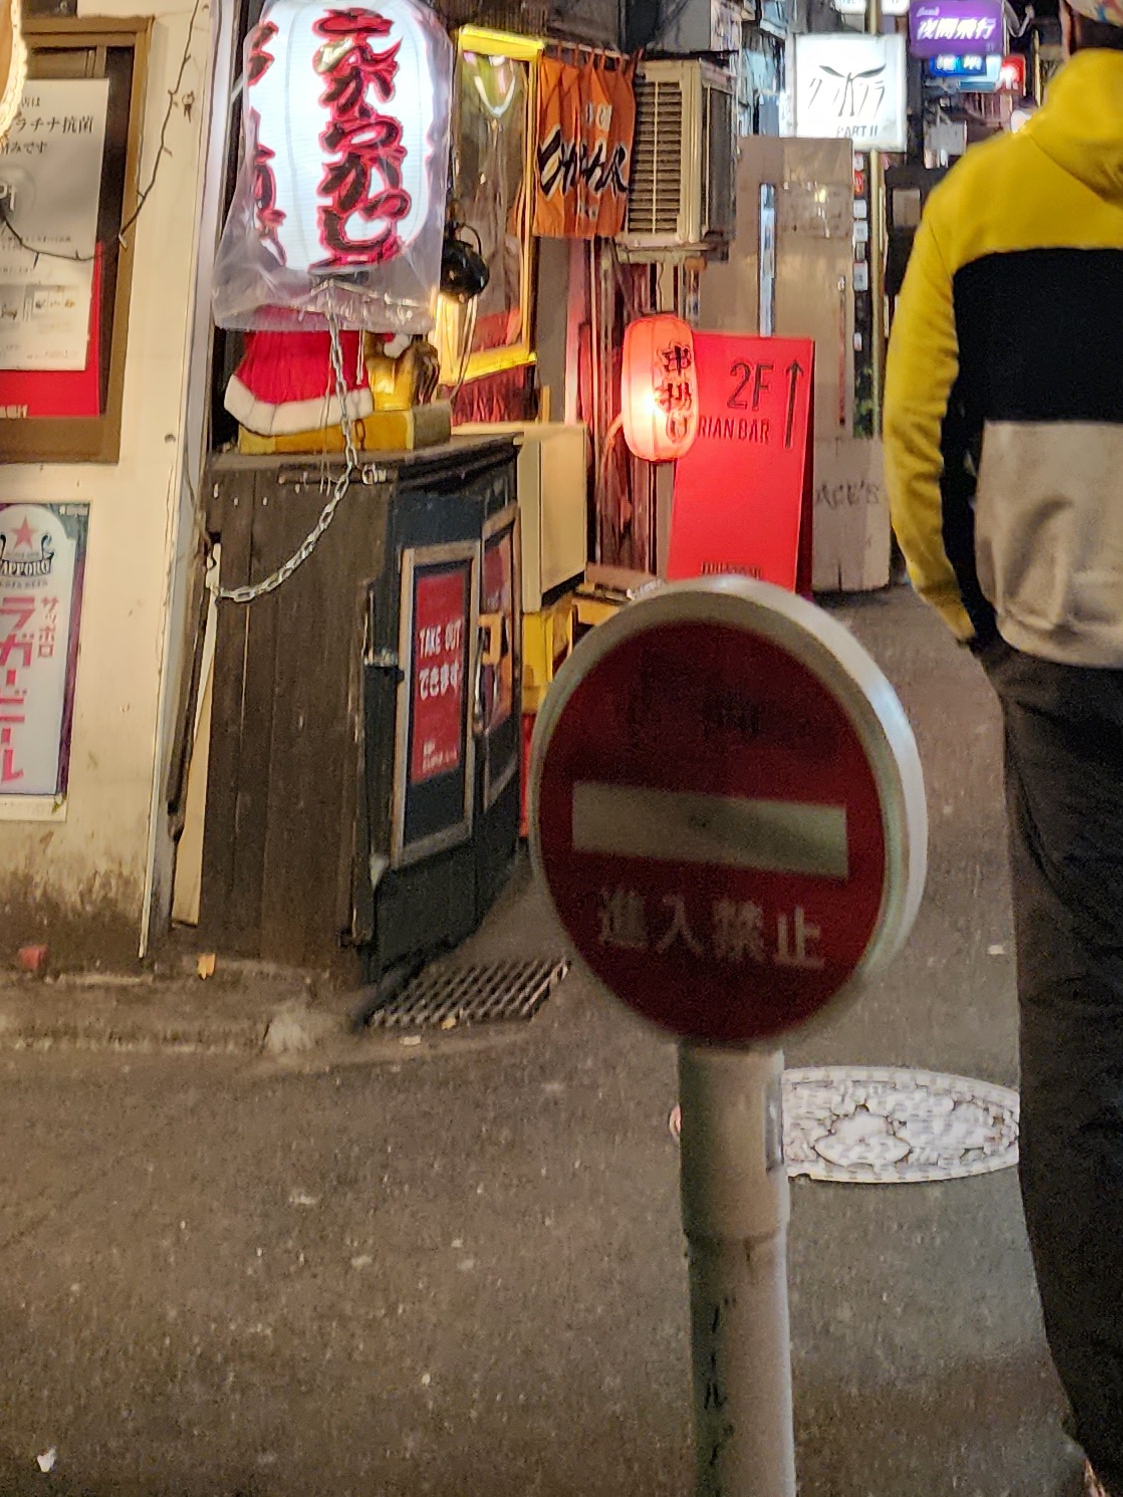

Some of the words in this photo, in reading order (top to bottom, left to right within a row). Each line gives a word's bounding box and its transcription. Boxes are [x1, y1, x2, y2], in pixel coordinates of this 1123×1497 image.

[14, 115, 94, 136] ラチナ抗菌
[726, 361, 773, 412] 2F
[738, 419, 771, 444] BAR
[0, 555, 52, 578] APPORO
[37, 596, 59, 658] サッポロ
[418, 624, 442, 659] TAKE
[445, 618, 462, 652] OUT
[601, 889, 827, 969] 進入禁止
